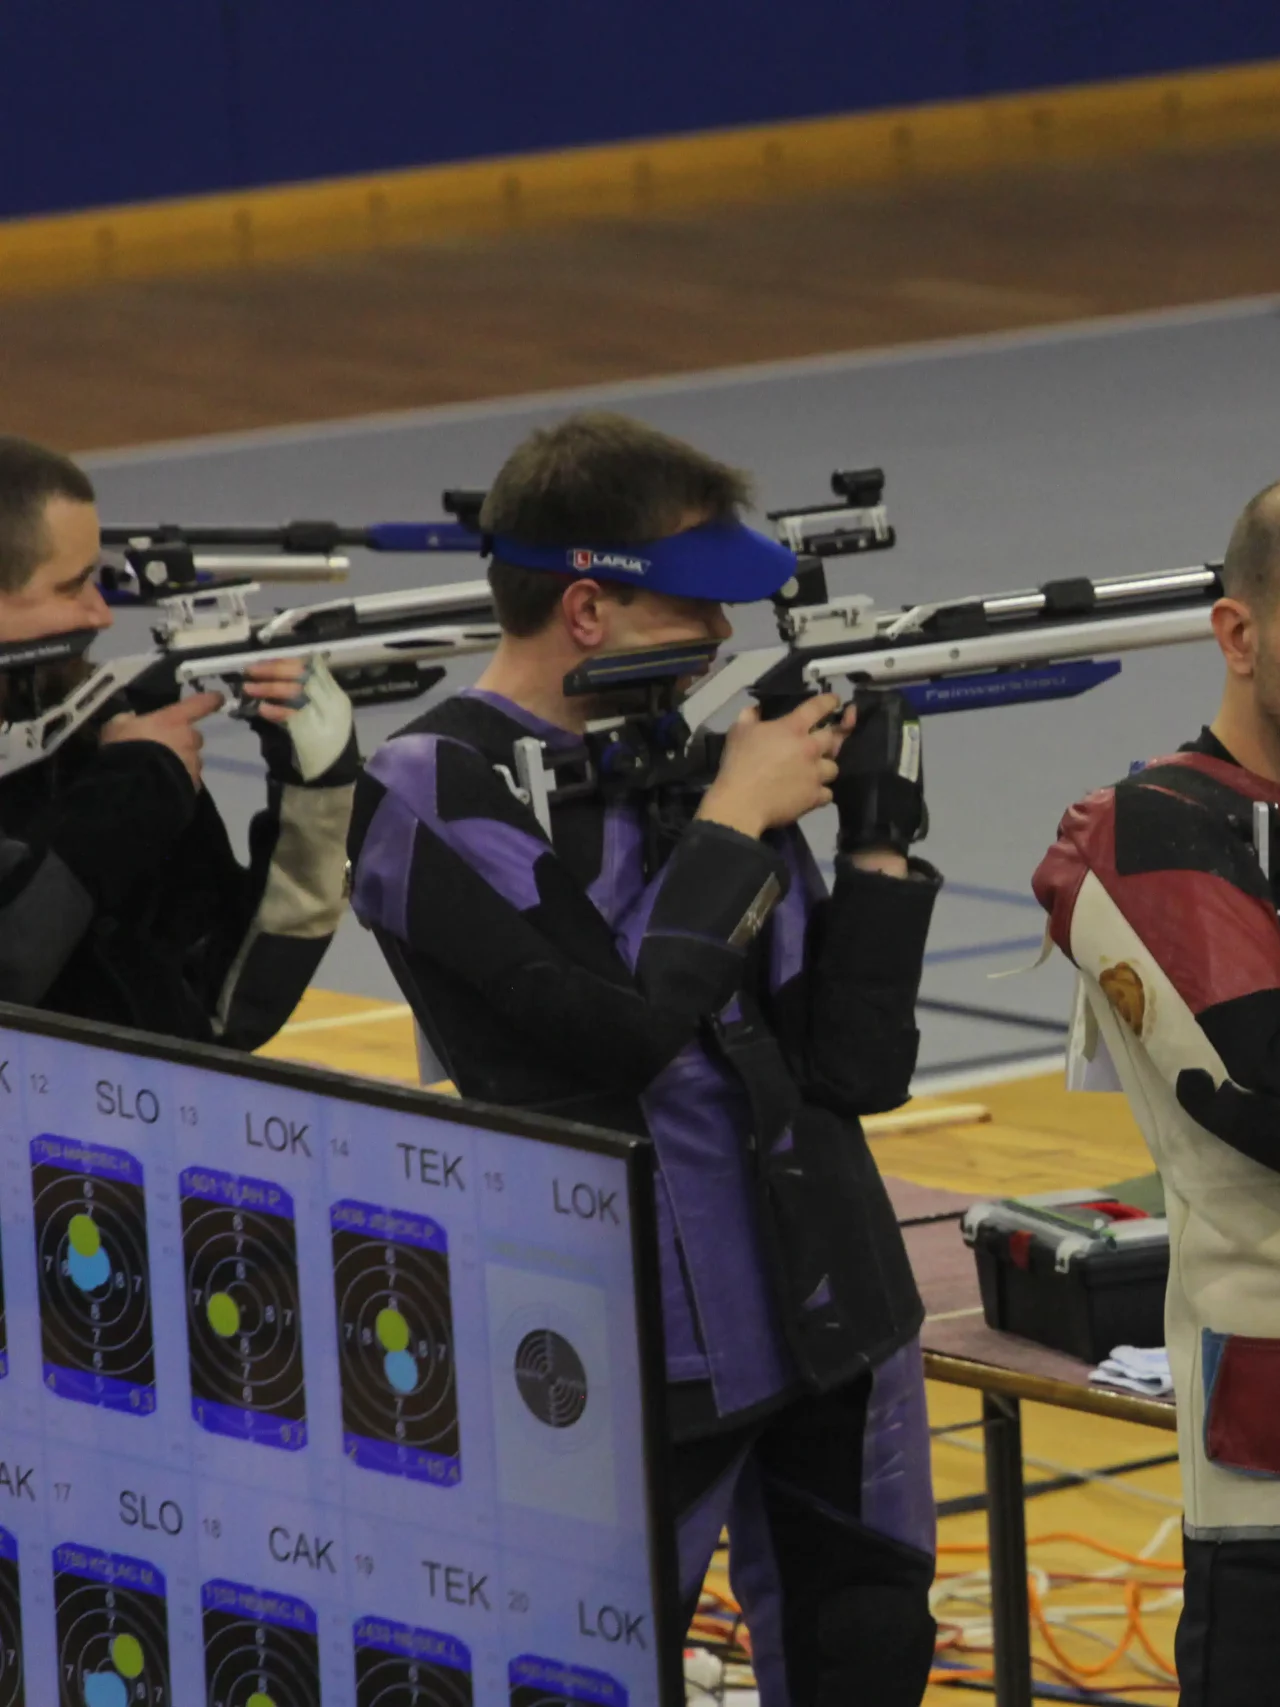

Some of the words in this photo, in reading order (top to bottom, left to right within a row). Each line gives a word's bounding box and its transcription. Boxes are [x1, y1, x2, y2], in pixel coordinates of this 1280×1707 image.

[593, 553, 645, 574] LAPUA
[30, 1073, 49, 1095] 12
[95, 1080, 160, 1124] SLO
[180, 1105, 199, 1127] 13
[245, 1111, 312, 1158] LOK
[330, 1138, 349, 1157] 14
[396, 1142, 465, 1192] TEK
[484, 1171, 504, 1192] 15
[552, 1177, 620, 1226] LOK
[54, 1482, 72, 1500] 17
[119, 1489, 184, 1536] SLO
[268, 1526, 337, 1574] CAK
[421, 1560, 491, 1611] TEK
[578, 1600, 647, 1650] LOK
